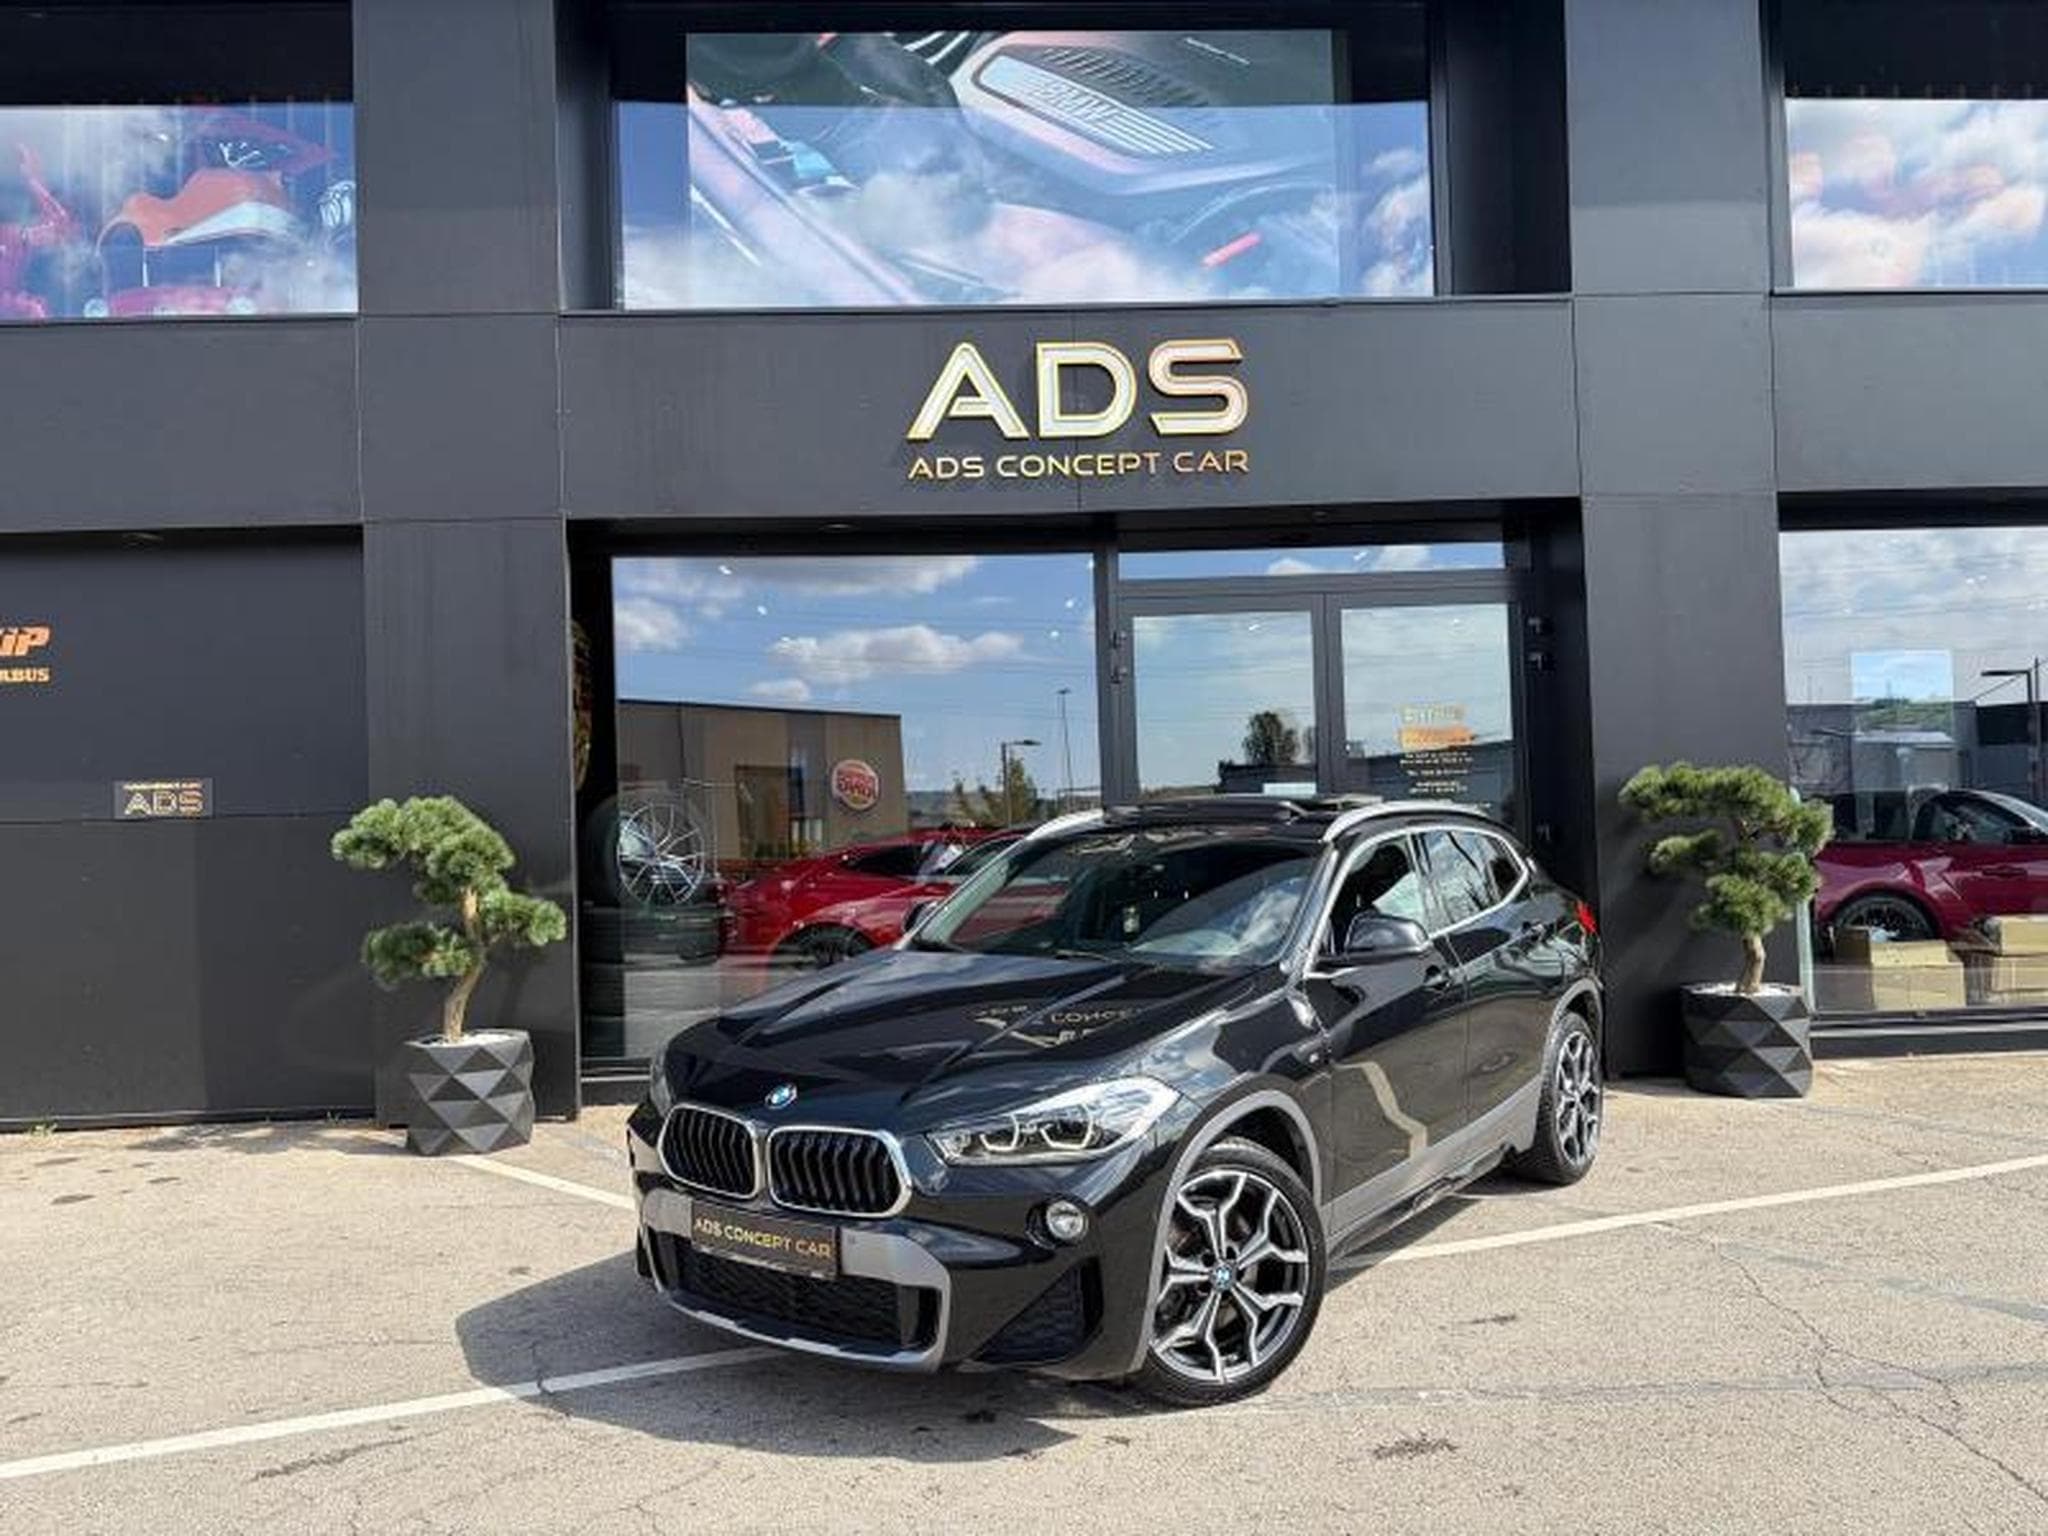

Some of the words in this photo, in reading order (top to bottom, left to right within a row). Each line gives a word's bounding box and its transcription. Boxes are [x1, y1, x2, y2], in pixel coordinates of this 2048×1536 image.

[907, 338, 1248, 440] ADS
[908, 456, 984, 480] ADS
[996, 451, 1161, 478] CONCEPT
[1173, 449, 1249, 473] CAR
[124, 790, 204, 816] ADS
[693, 1217, 723, 1238] ADS
[723, 1224, 792, 1252] CONCEPT
[795, 1240, 832, 1259] CAR
